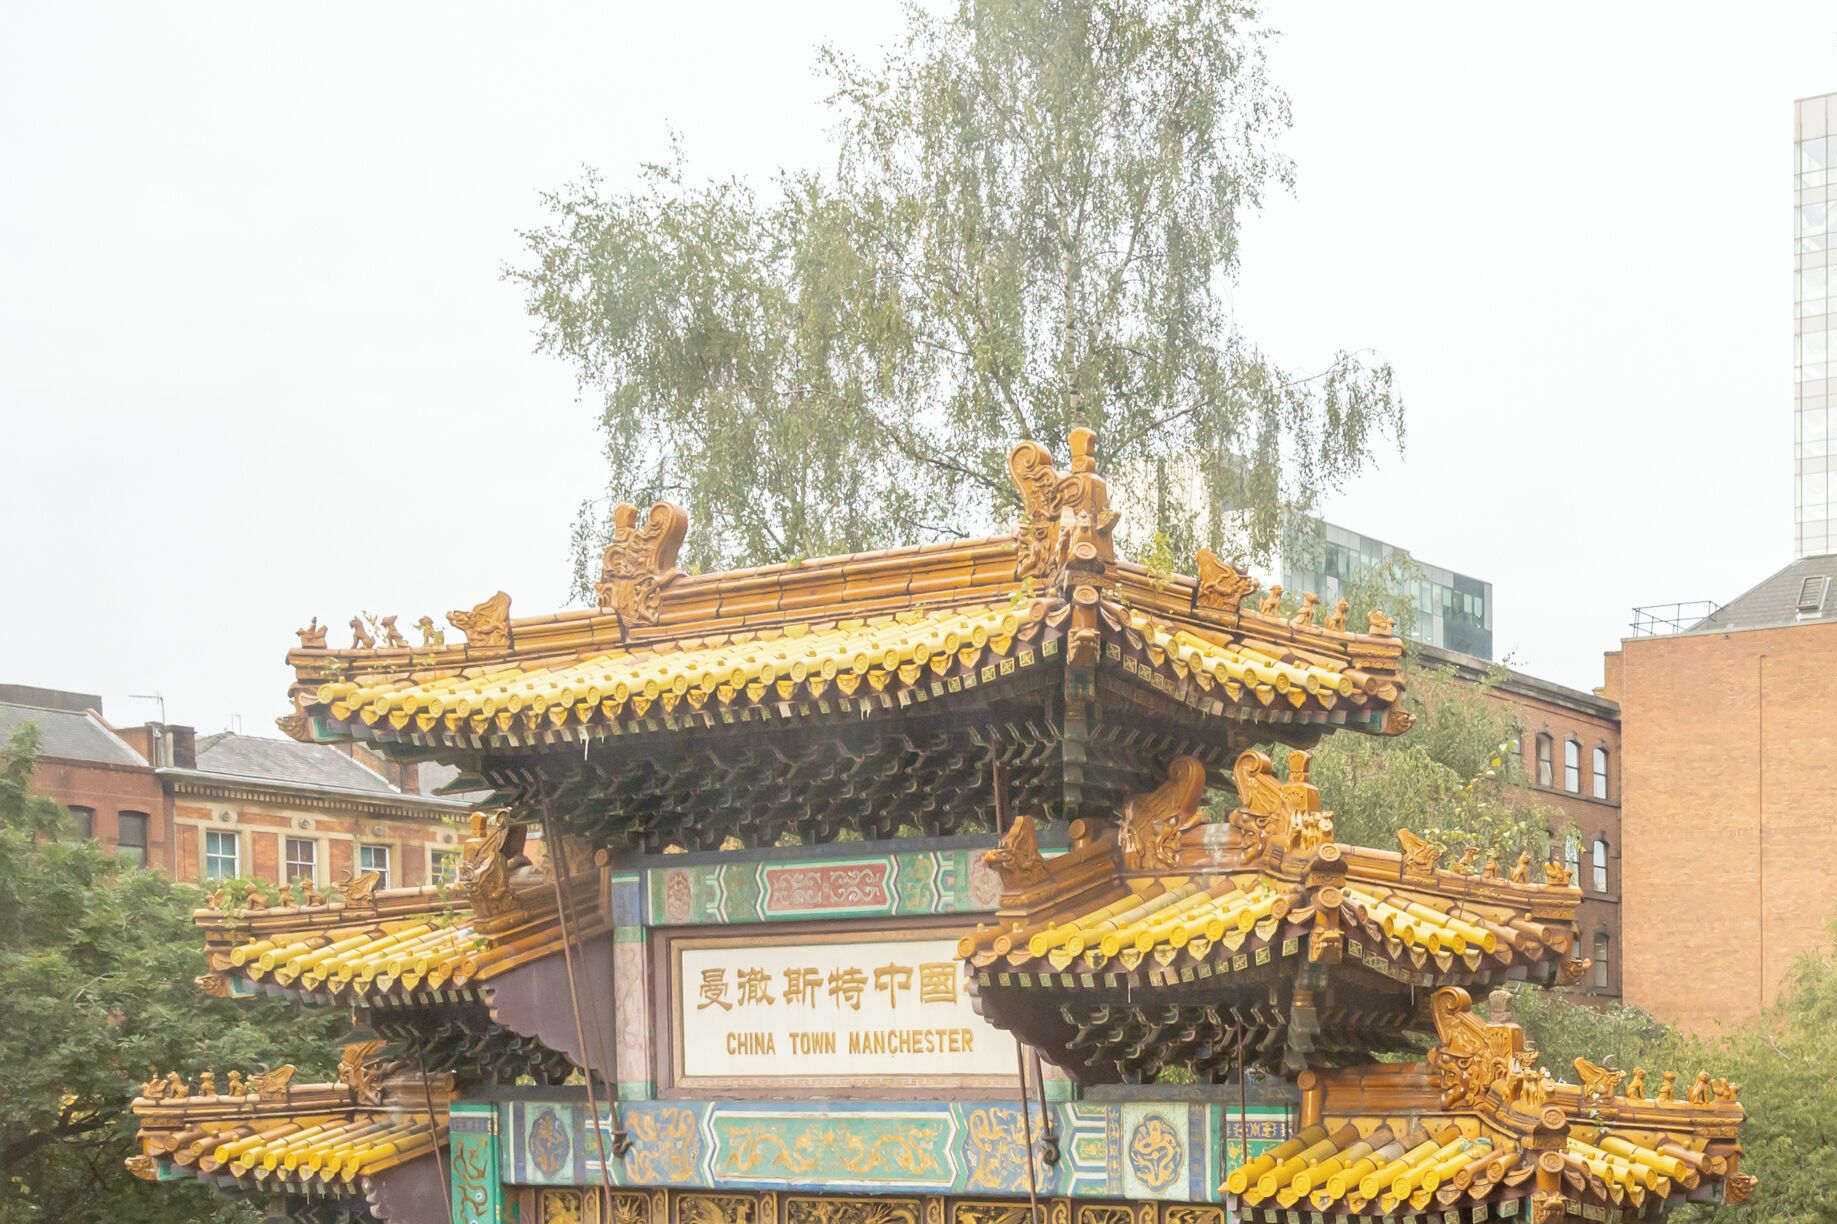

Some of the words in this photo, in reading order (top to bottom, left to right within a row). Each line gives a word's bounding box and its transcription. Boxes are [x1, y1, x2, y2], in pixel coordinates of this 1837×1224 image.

[726, 1031, 776, 1056] CHINA
[789, 1031, 837, 1055] TOWN
[848, 1028, 975, 1055] MANCHESTER
